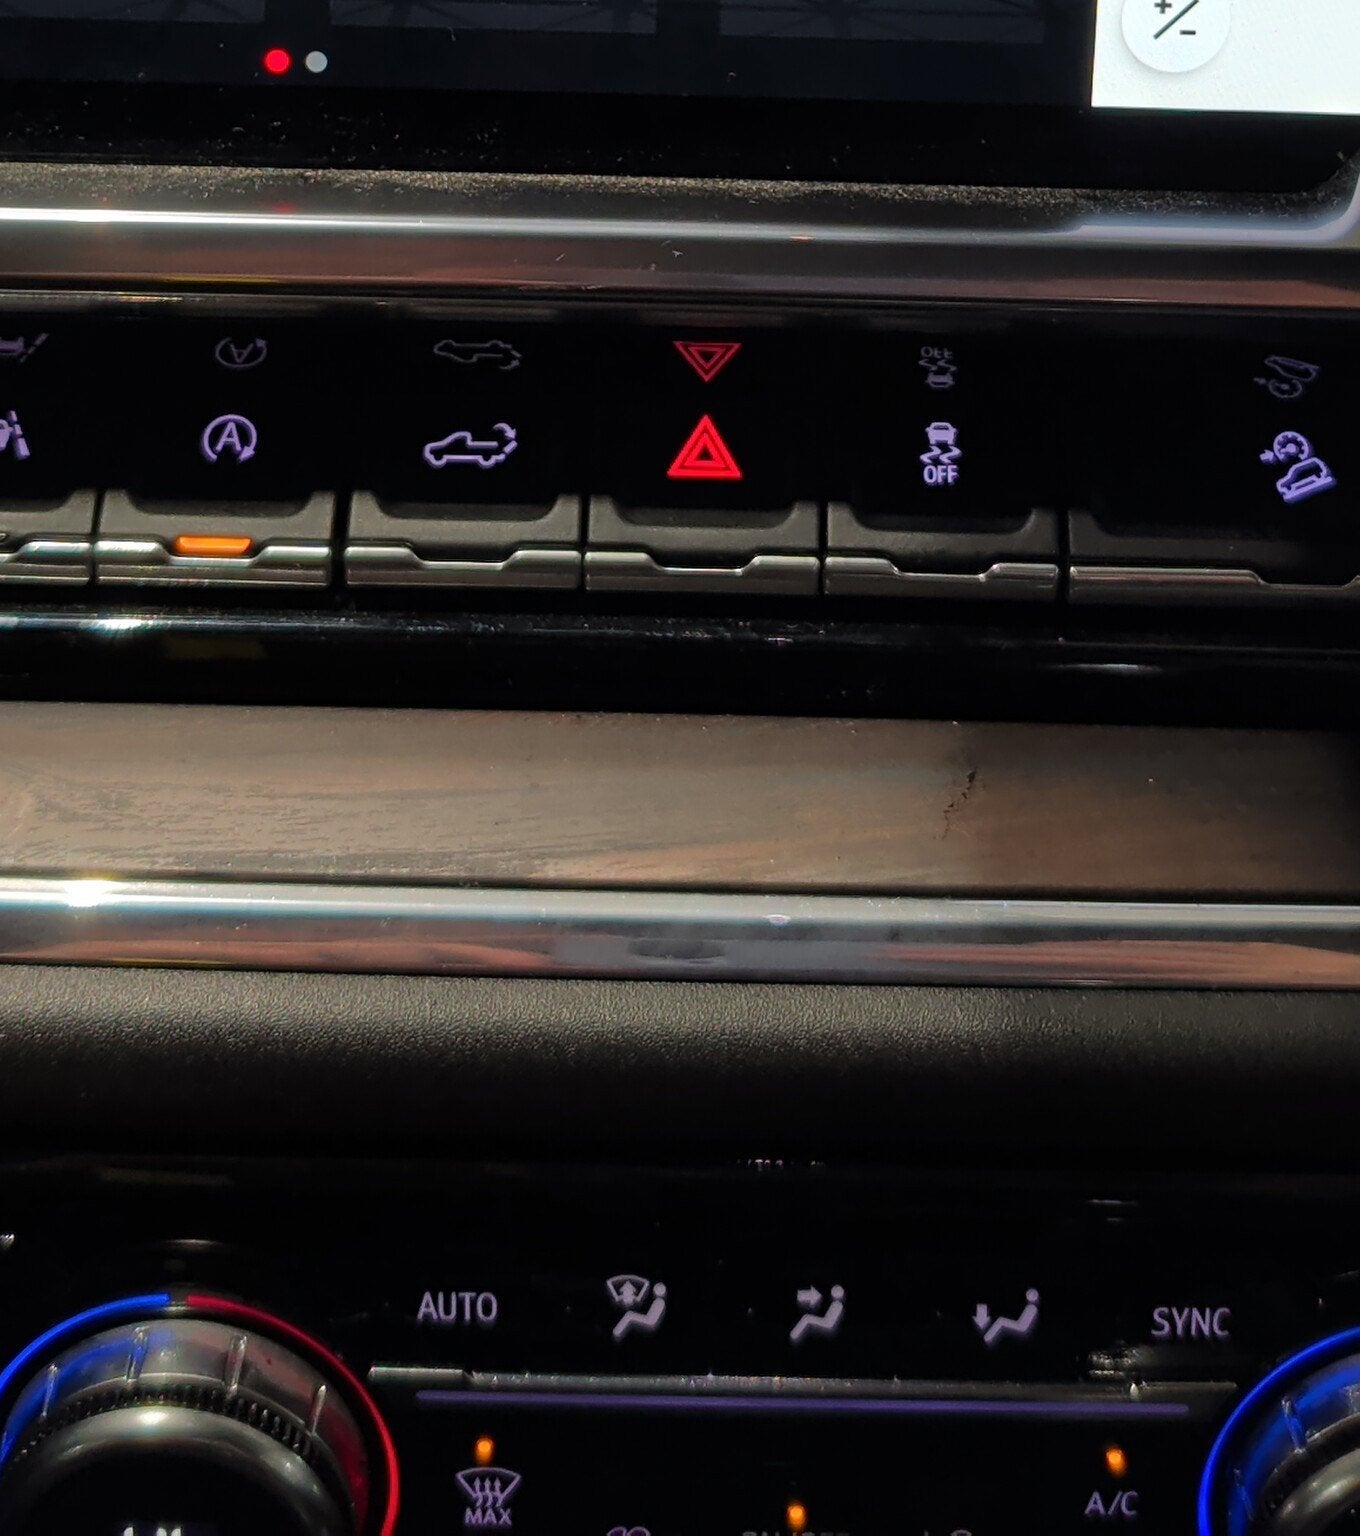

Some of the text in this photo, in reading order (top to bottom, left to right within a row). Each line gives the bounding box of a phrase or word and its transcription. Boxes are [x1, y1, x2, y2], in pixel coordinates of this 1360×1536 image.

[924, 464, 959, 485] OFF
[417, 1291, 499, 1323] AUTO
[1151, 1306, 1230, 1340] SYNC
[464, 1507, 513, 1528] MAX
[1085, 1490, 1139, 1518] A/C
